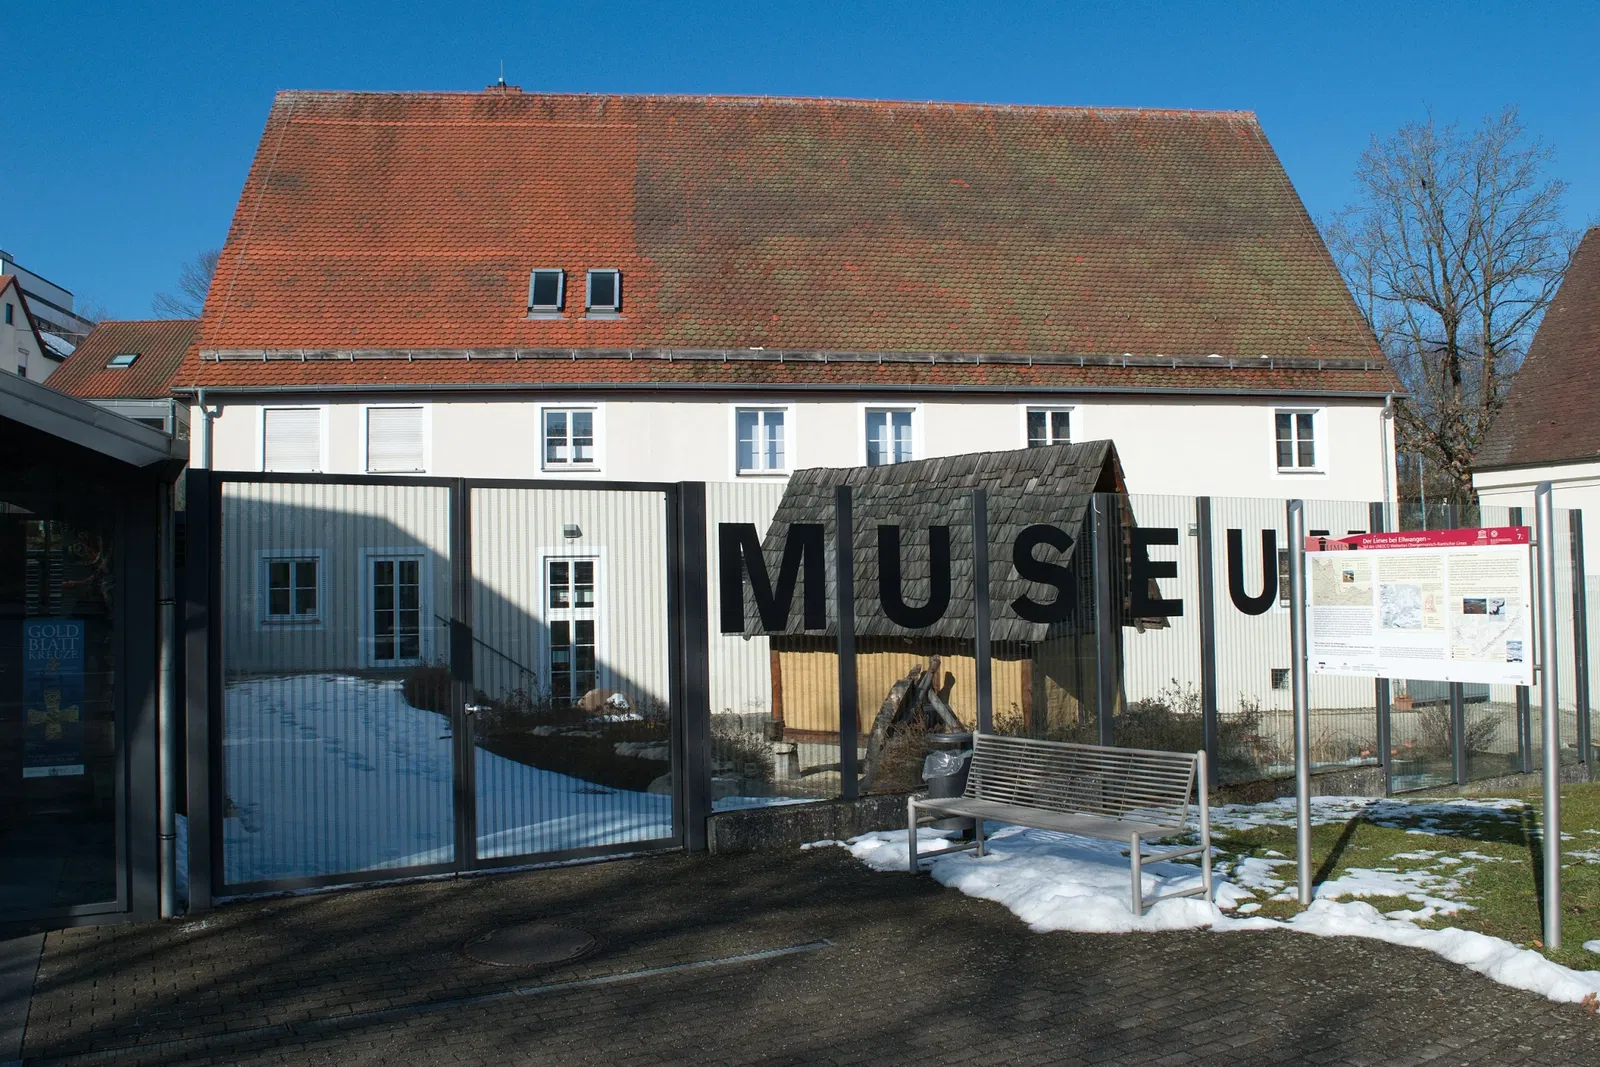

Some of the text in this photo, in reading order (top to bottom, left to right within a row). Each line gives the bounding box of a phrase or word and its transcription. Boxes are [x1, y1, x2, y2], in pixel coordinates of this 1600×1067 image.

[718, 521, 1367, 634] MUSEU
[28, 625, 79, 638] GOLD
[28, 638, 79, 651] BLATT
[28, 650, 79, 660] KREUZE
